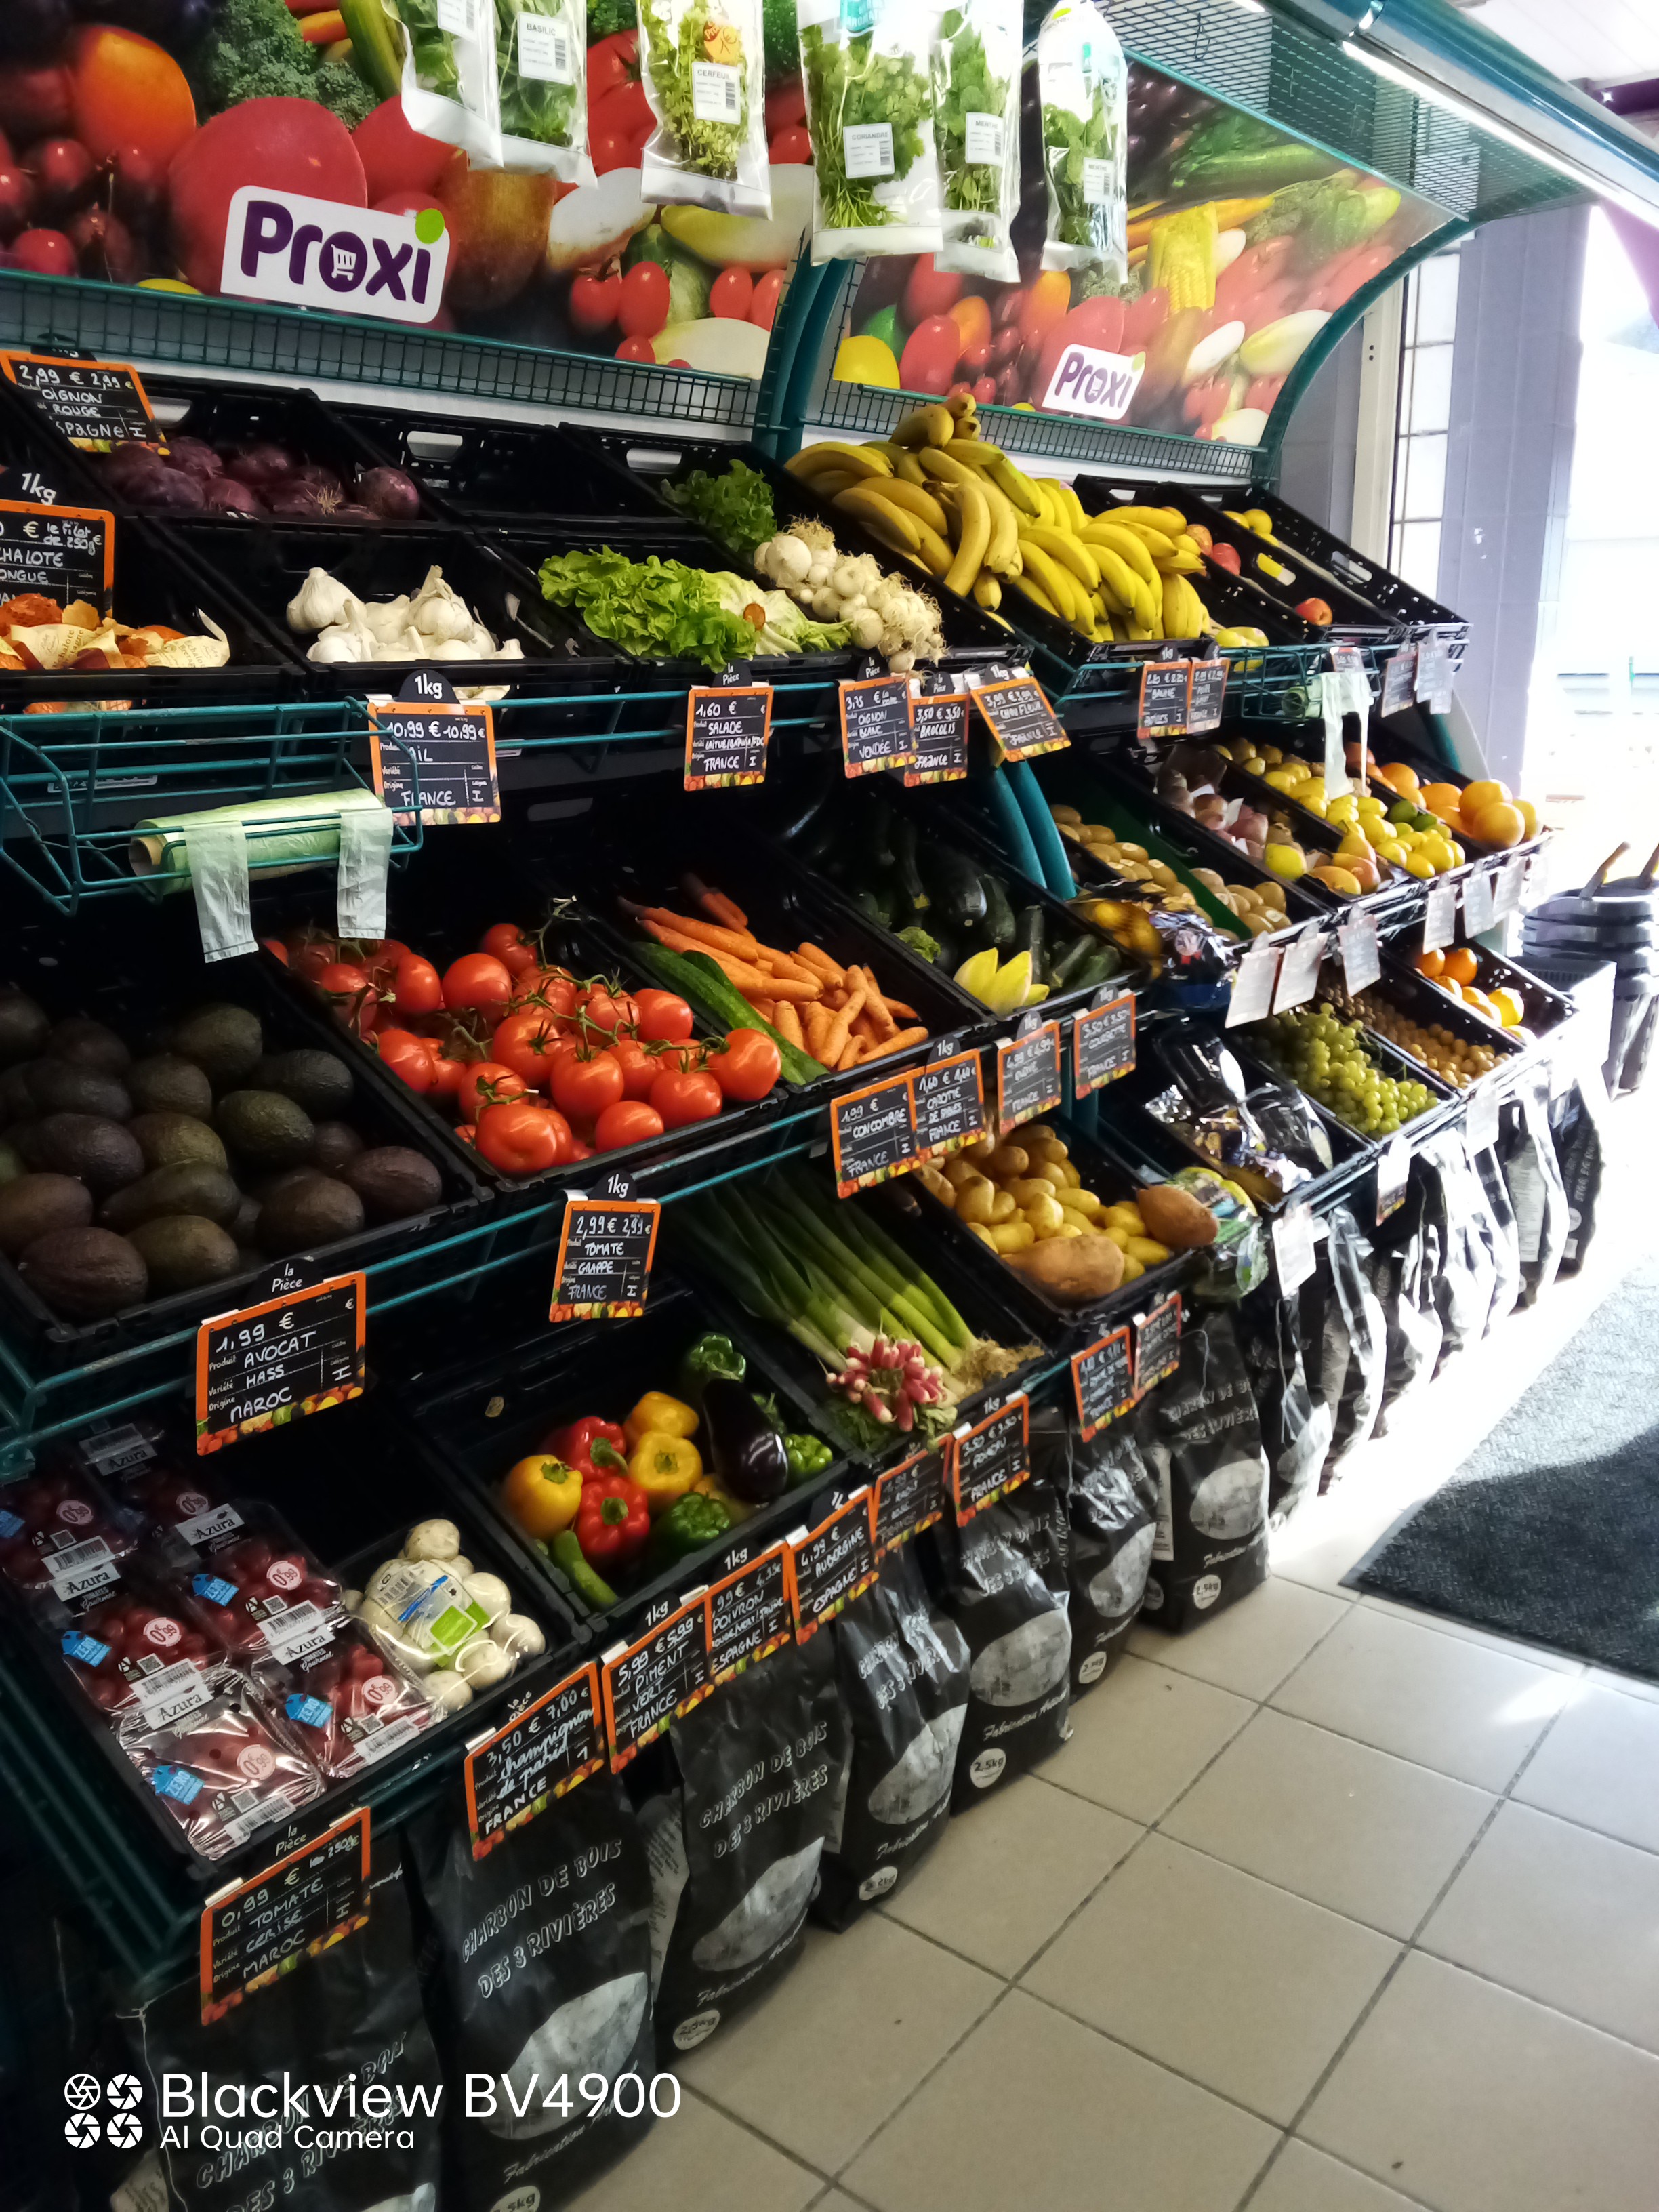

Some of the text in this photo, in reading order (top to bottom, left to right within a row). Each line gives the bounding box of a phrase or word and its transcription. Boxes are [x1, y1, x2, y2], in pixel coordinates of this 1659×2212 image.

[241, 200, 445, 304] Proxi
[19, 365, 60, 386] 2,99
[91, 373, 121, 390] 2,99
[1054, 350, 1146, 408] Proxi
[52, 403, 102, 417] ROUGE
[22, 472, 57, 506] 1kg
[414, 672, 443, 699] 1kg
[695, 701, 721, 718] 1,60
[386, 720, 425, 739] 10,99
[443, 723, 477, 741] 10,99
[708, 720, 743, 736] SALADE
[703, 755, 740, 773] FRANCE
[401, 790, 456, 807] FANCE
[853, 1107, 907, 1139] CONCOMBRE
[847, 1151, 890, 1178] FRANCE
[607, 1173, 630, 1199] 1kg
[576, 1215, 606, 1240] 2,99
[584, 1242, 625, 1256] TOMATE
[284, 1263, 294, 1277] la
[577, 1261, 614, 1275] GRAPPE
[271, 1277, 303, 1293] Pièce
[567, 1284, 607, 1301] FRANCE
[208, 1330, 317, 1372] Produit AVOCAT
[215, 1323, 266, 1353] 1,99
[246, 1364, 285, 1390] HASS
[108, 1449, 148, 1471] Azura
[195, 1519, 236, 1540] Azura
[724, 1547, 749, 1571] 1kg
[66, 1572, 111, 1594] Azura
[813, 1566, 857, 1613] ESPAGNE
[645, 1601, 669, 1626] 1kg
[712, 1589, 733, 1618] ,99
[285, 1635, 327, 1658] Azura
[617, 1650, 649, 1687] 5,99
[159, 1694, 203, 1721] Azura
[632, 1677, 665, 1713] VERT
[630, 1688, 678, 1739] FRANCE
[486, 1729, 523, 1769] 3,50
[545, 1688, 578, 1719] 7,00
[699, 1760, 765, 1829] CHARBON
[770, 1744, 793, 1774] DE
[485, 1776, 548, 1835] FRANCE
[288, 1824, 298, 1838] la
[275, 1833, 307, 1857] Pièce
[221, 1888, 270, 1929] 0,99
[249, 1877, 324, 1929] TOMATE
[462, 1883, 533, 1964] CHARBON
[539, 1864, 569, 1898] DE
[574, 1839, 623, 1878] BOIS
[478, 1881, 617, 2000] DES 3 RIVIÈRES
[243, 1929, 306, 1979] MAROC
